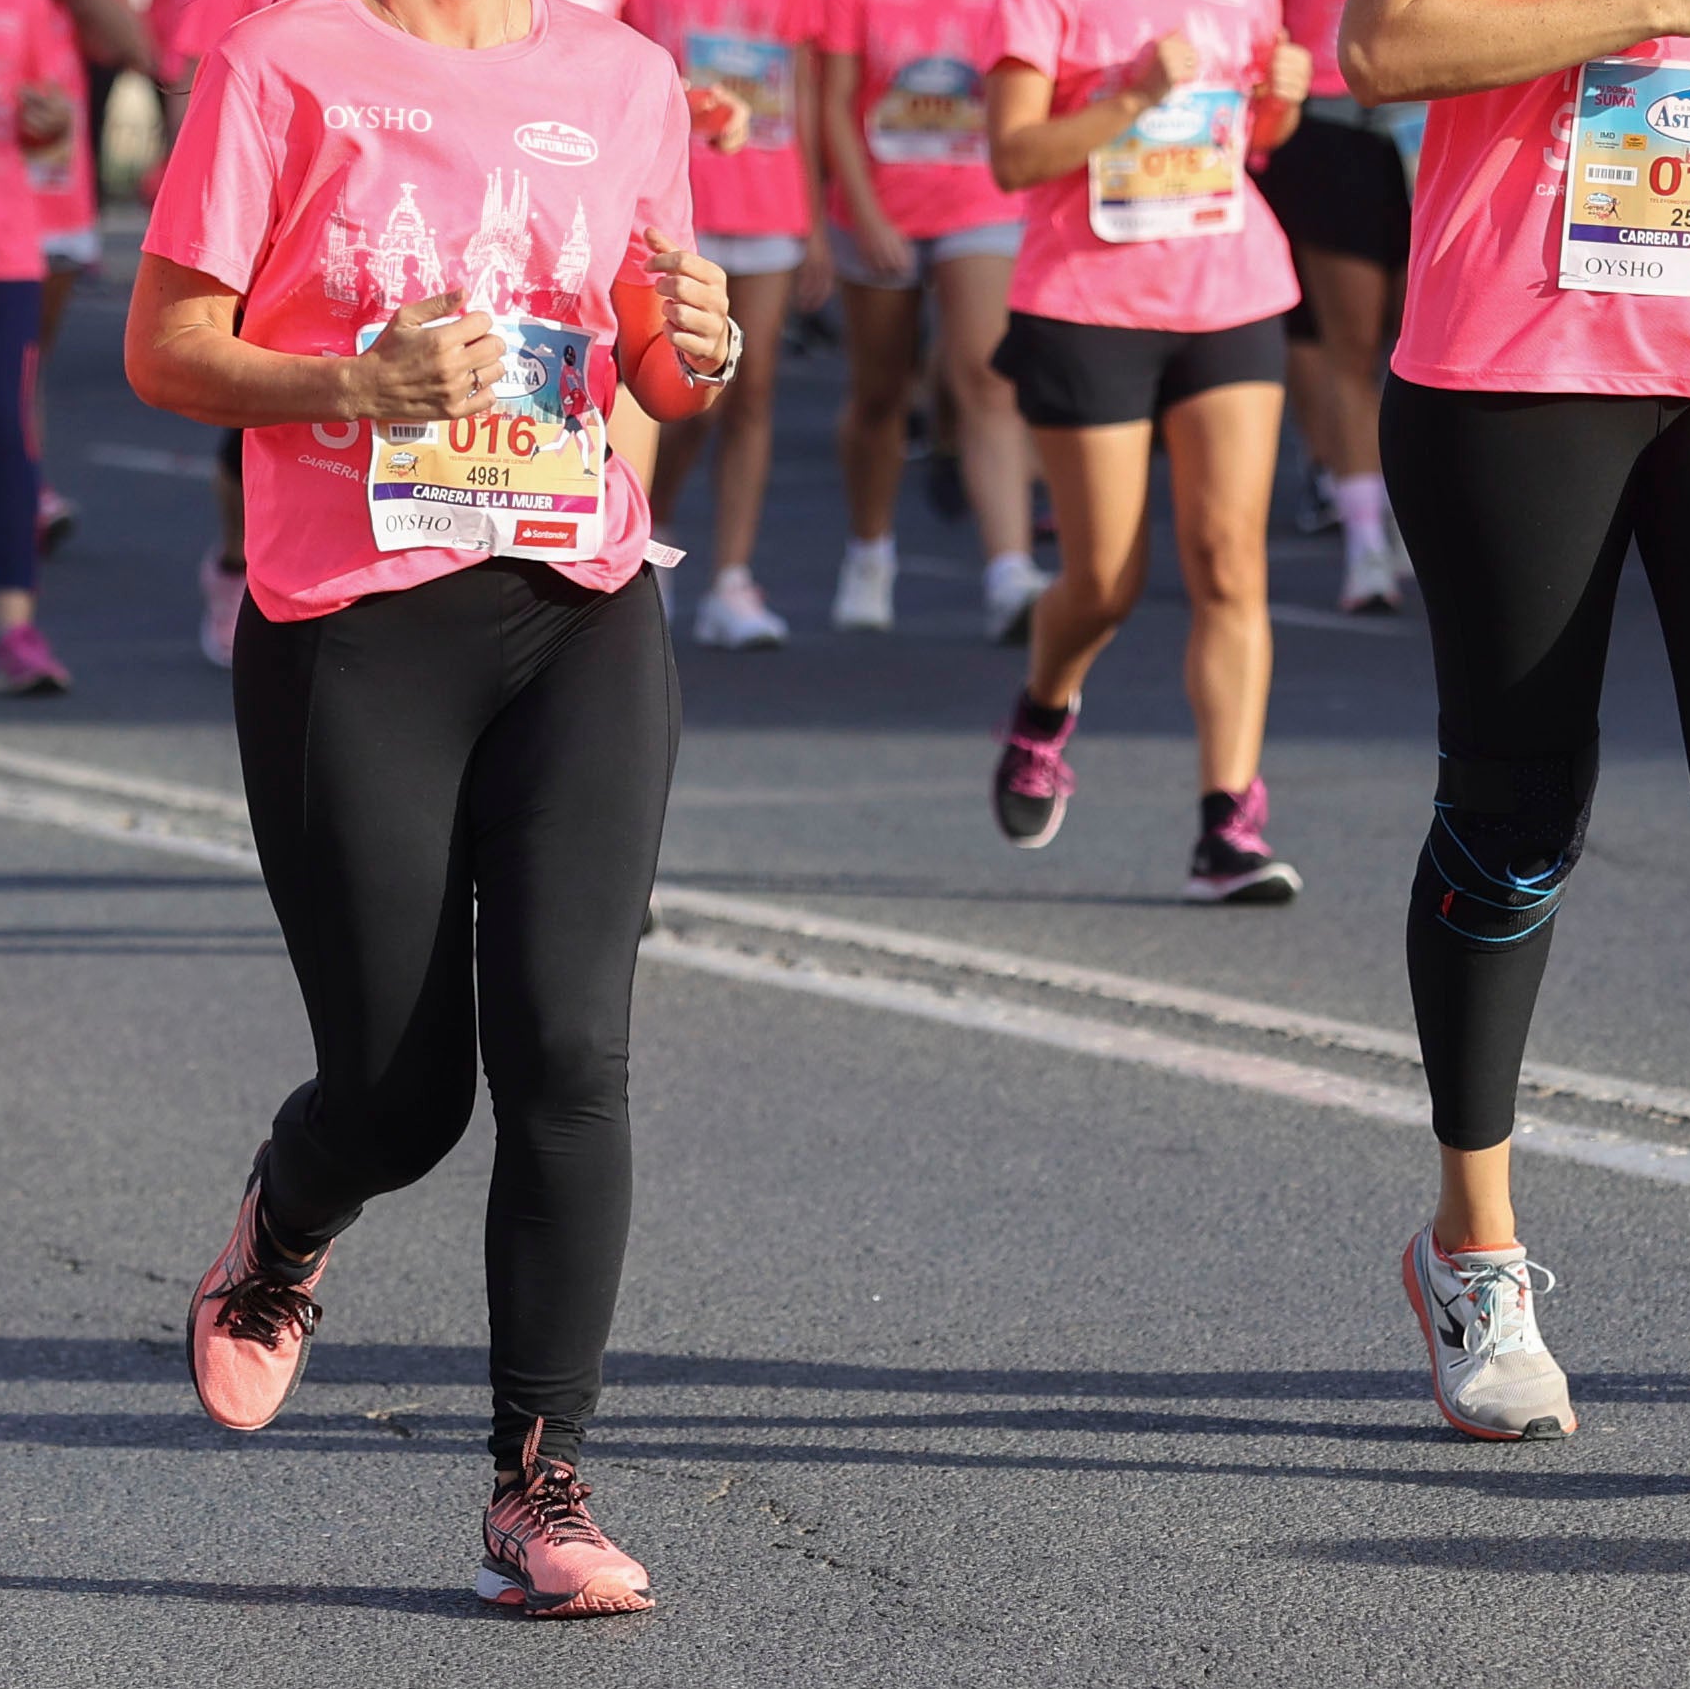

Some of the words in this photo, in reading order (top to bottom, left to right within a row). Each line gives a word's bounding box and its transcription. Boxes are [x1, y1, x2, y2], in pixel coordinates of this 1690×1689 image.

[1594, 93, 1636, 108] SUMA
[324, 105, 433, 132] OYSHO
[519, 131, 592, 158] ASTURIANA
[1618, 229, 1678, 246] CARRERA
[1585, 257, 1663, 279] OYSHO
[448, 414, 536, 457] 016
[297, 454, 360, 482] CARRERA
[466, 466, 510, 487] 4981
[412, 484, 473, 505] CARRERA
[476, 492, 490, 507] DE
[492, 493, 508, 508] LA
[512, 495, 553, 510] MUJER
[386, 514, 452, 533] OYSHO
[532, 528, 569, 541] Santander
